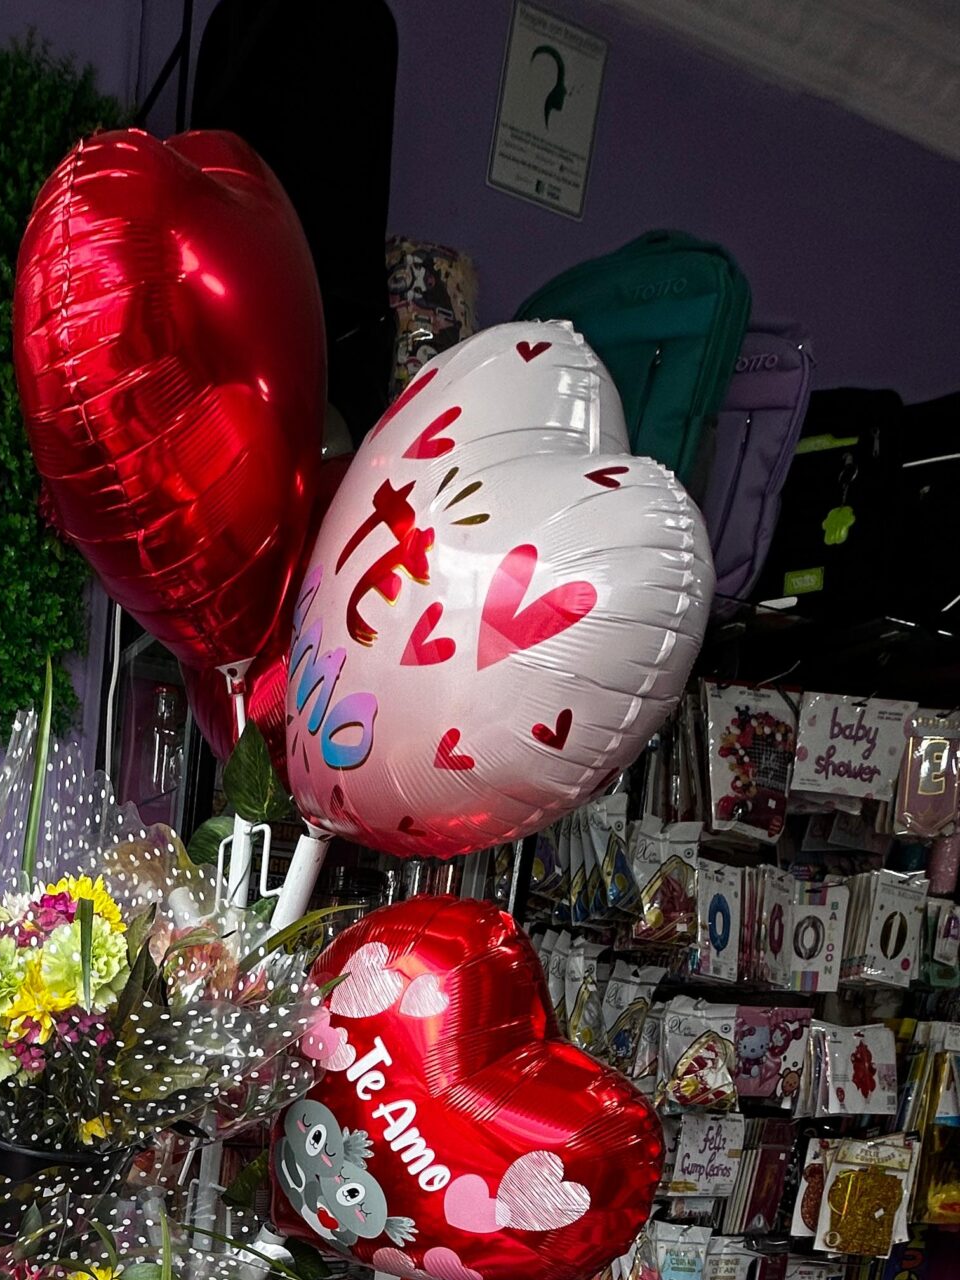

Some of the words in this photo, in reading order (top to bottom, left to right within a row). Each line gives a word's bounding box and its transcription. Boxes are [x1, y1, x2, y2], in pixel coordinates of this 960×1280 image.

[735, 354, 778, 373] OTTO
[829, 706, 879, 761] baby
[814, 744, 881, 784] shower
[345, 1035, 394, 1102] Te
[371, 1098, 452, 1193] Amo
